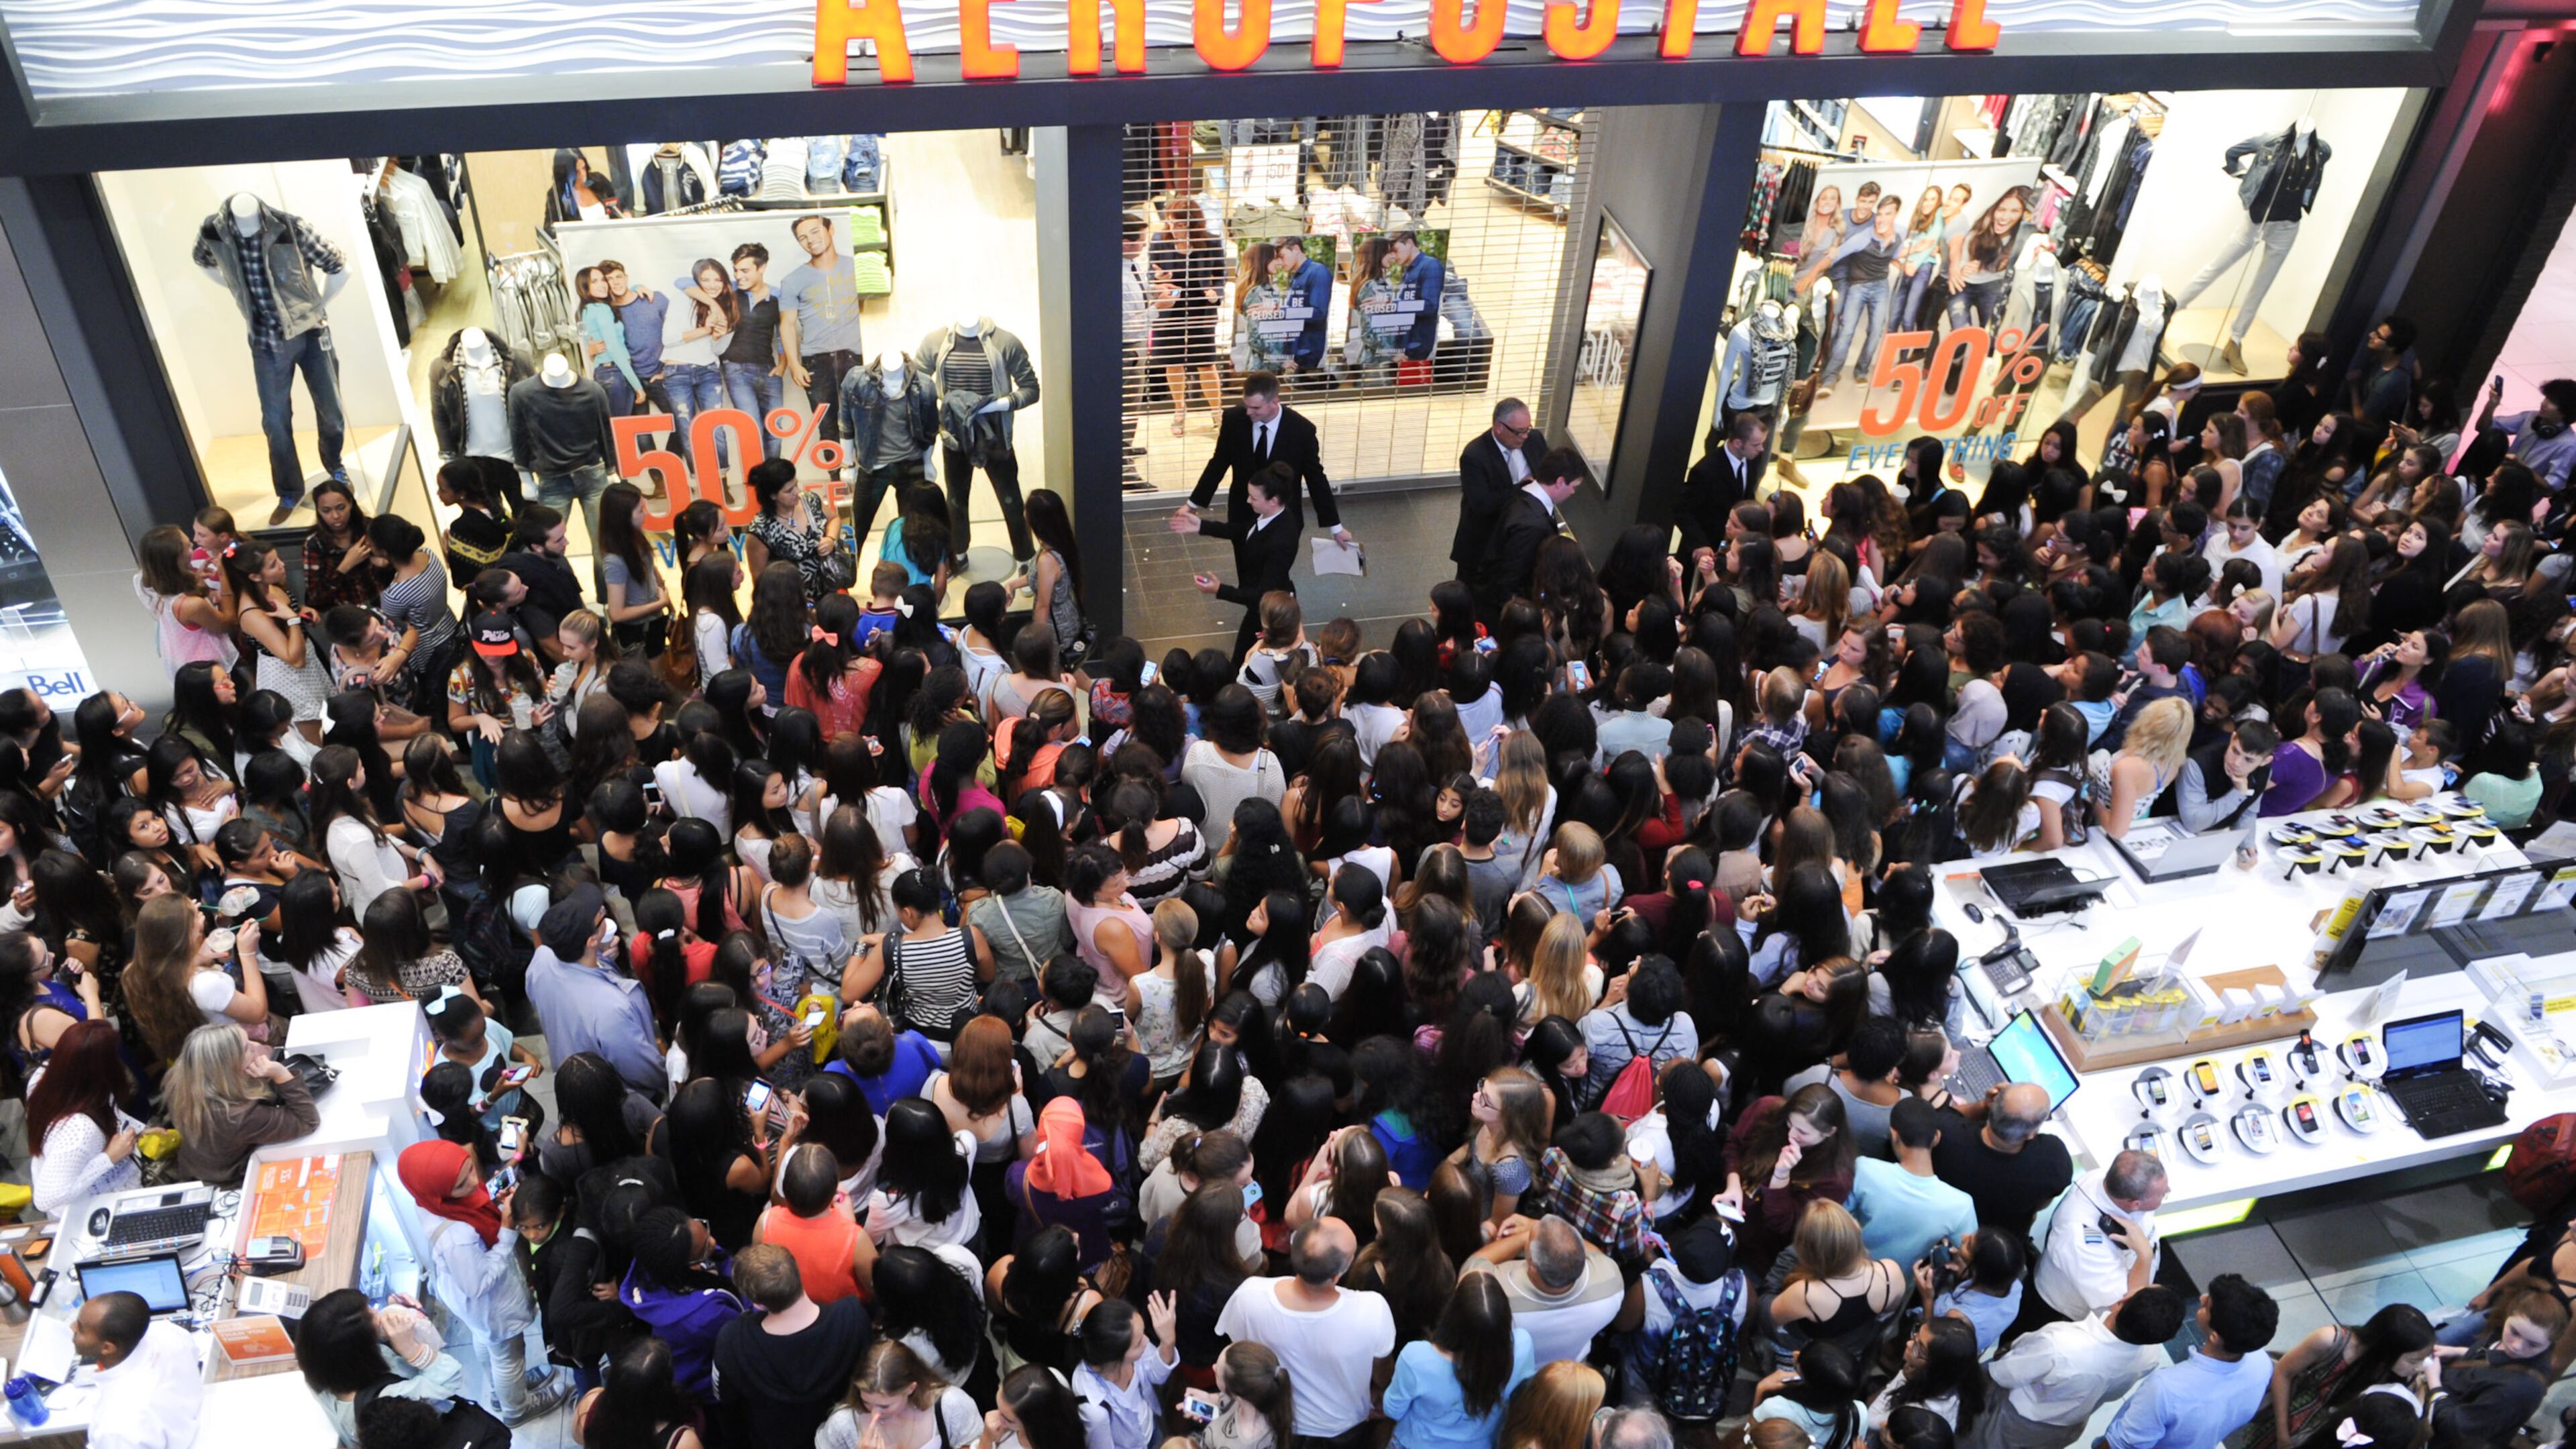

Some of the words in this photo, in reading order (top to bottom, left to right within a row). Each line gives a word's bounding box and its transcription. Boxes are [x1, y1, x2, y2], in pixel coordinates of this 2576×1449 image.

[1292, 297, 1305, 307] BE
[1404, 290, 1416, 300] BE
[1252, 310, 1285, 320] CLOSED
[1364, 303, 1397, 314] CLOSED
[1859, 323, 2048, 437] 50%
[1973, 392, 2030, 428] OFF
[1847, 431, 2017, 472] EVETHING
[609, 403, 845, 532] 50%
[27, 672, 86, 696] Bell
